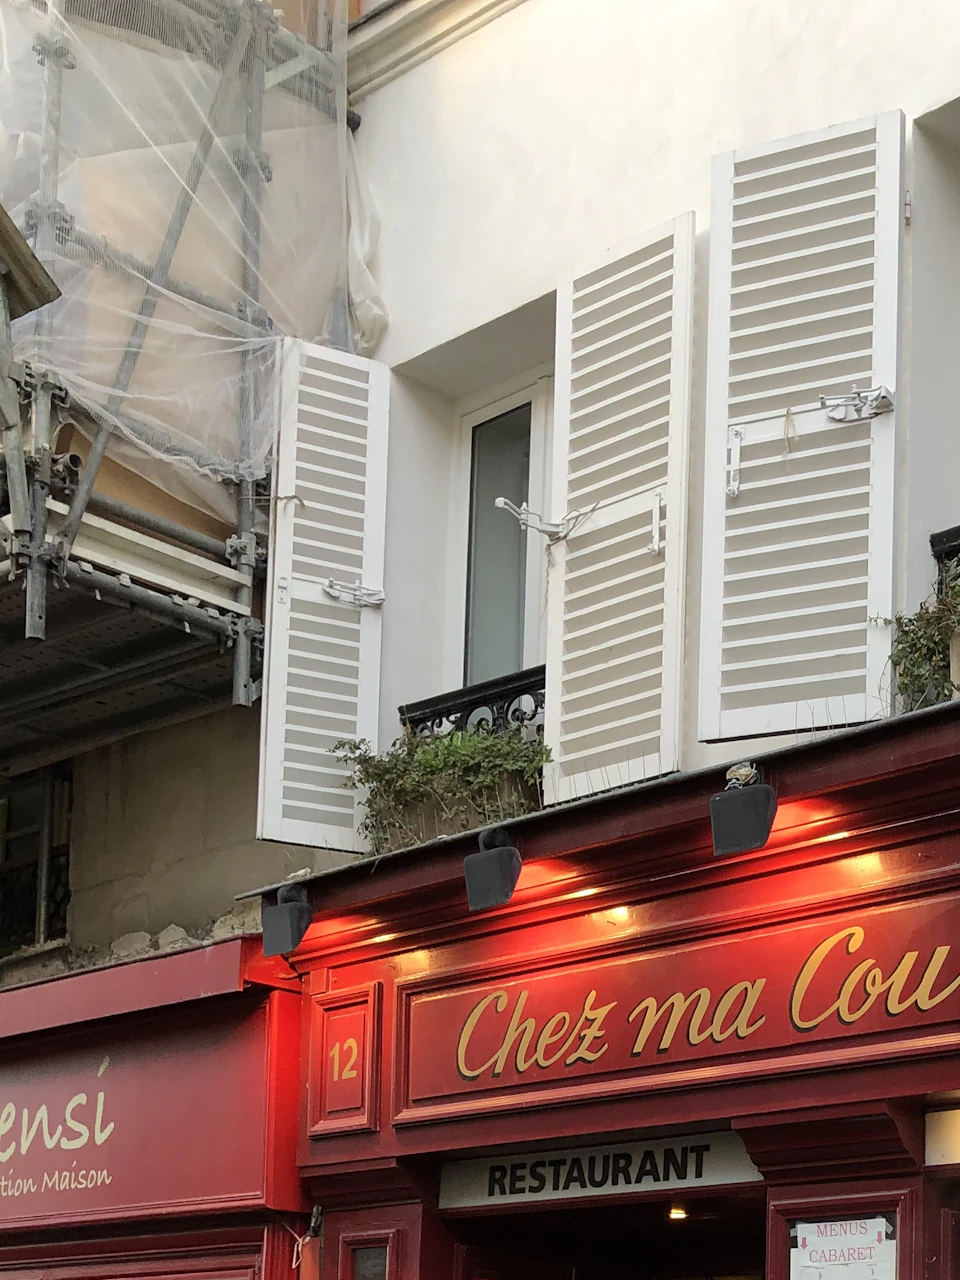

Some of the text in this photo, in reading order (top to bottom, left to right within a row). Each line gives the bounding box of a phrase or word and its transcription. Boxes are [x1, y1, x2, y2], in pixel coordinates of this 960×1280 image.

[457, 990, 608, 1080] Chez
[631, 977, 765, 1055] ma
[329, 1038, 359, 1081] 12
[41, 1160, 112, 1193] Maison
[487, 1143, 710, 1197] RESTAURANT
[816, 1222, 868, 1237] MENUS
[809, 1247, 875, 1263] CABARET
